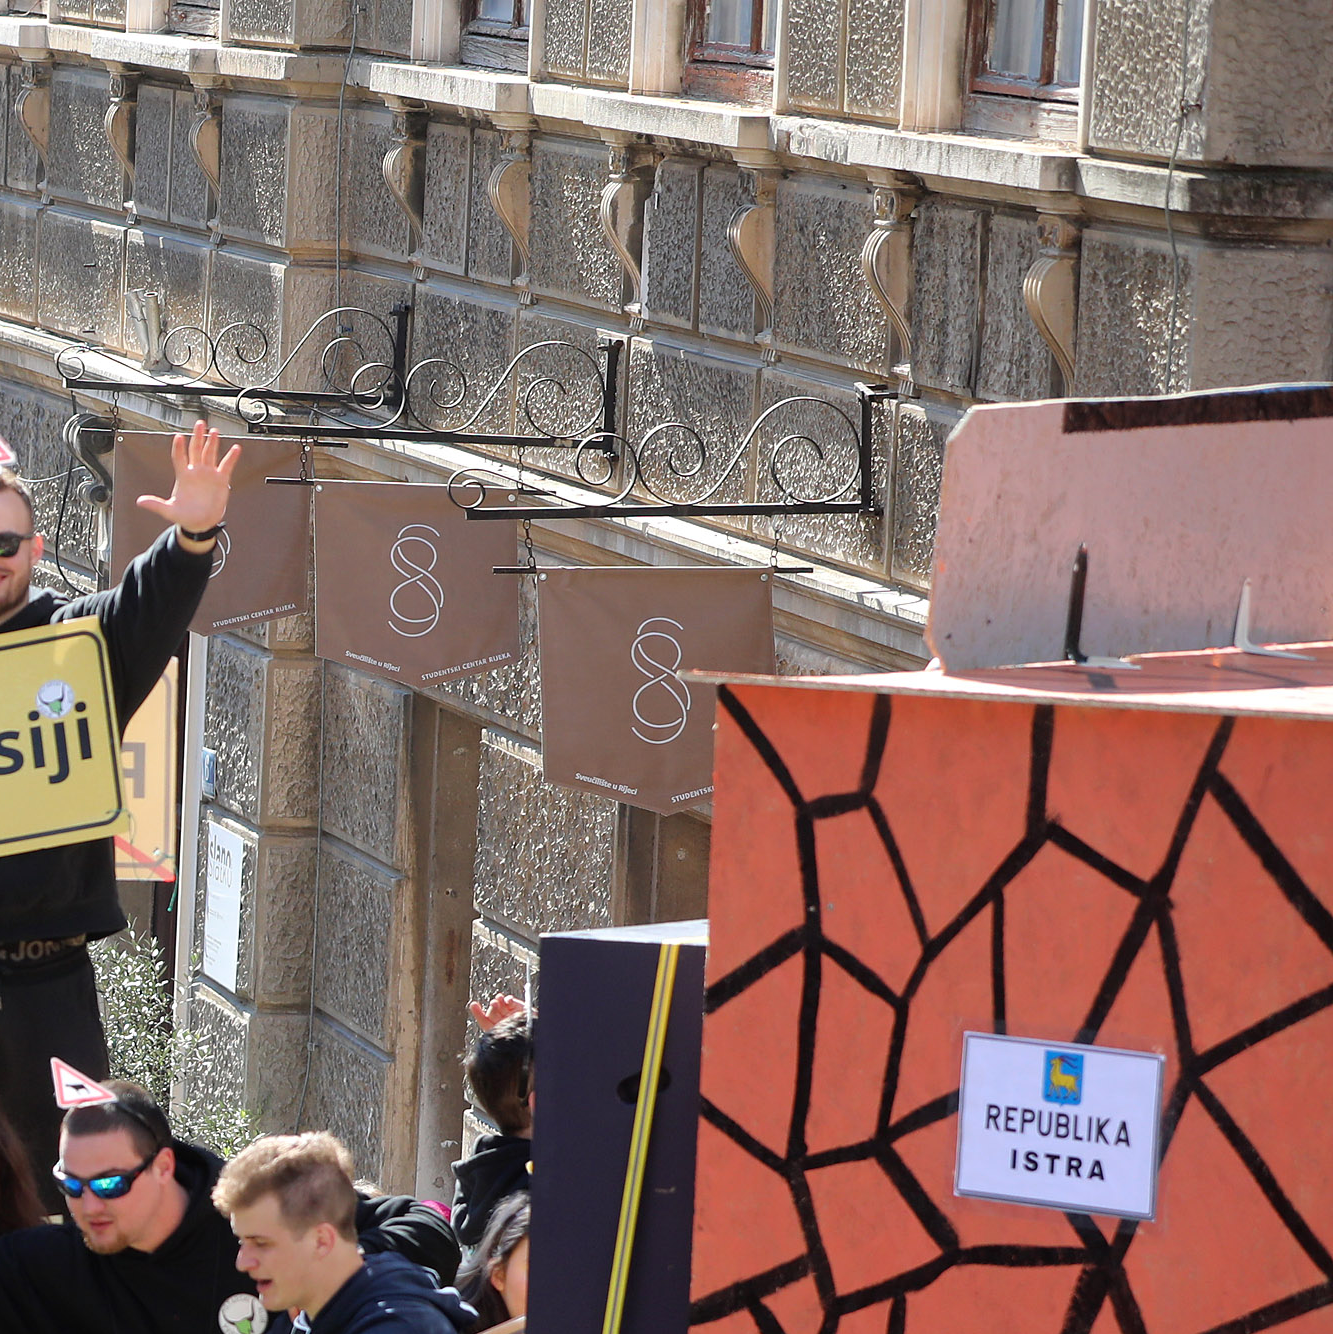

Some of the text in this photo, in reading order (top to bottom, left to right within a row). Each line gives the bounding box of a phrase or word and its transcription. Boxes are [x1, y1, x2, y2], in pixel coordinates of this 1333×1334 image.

[212, 602, 297, 628] STUDENTSKI CENTAR RIJEKA
[420, 651, 513, 682] STUDENTSKI CENTAR RIJEKA
[574, 772, 613, 790] Sveučilište
[618, 785, 639, 797] Rijeci
[670, 784, 716, 805] STUDENTSKI
[984, 1102, 1132, 1148] REPUBLIKA
[1009, 1148, 1107, 1182] ISTRA
